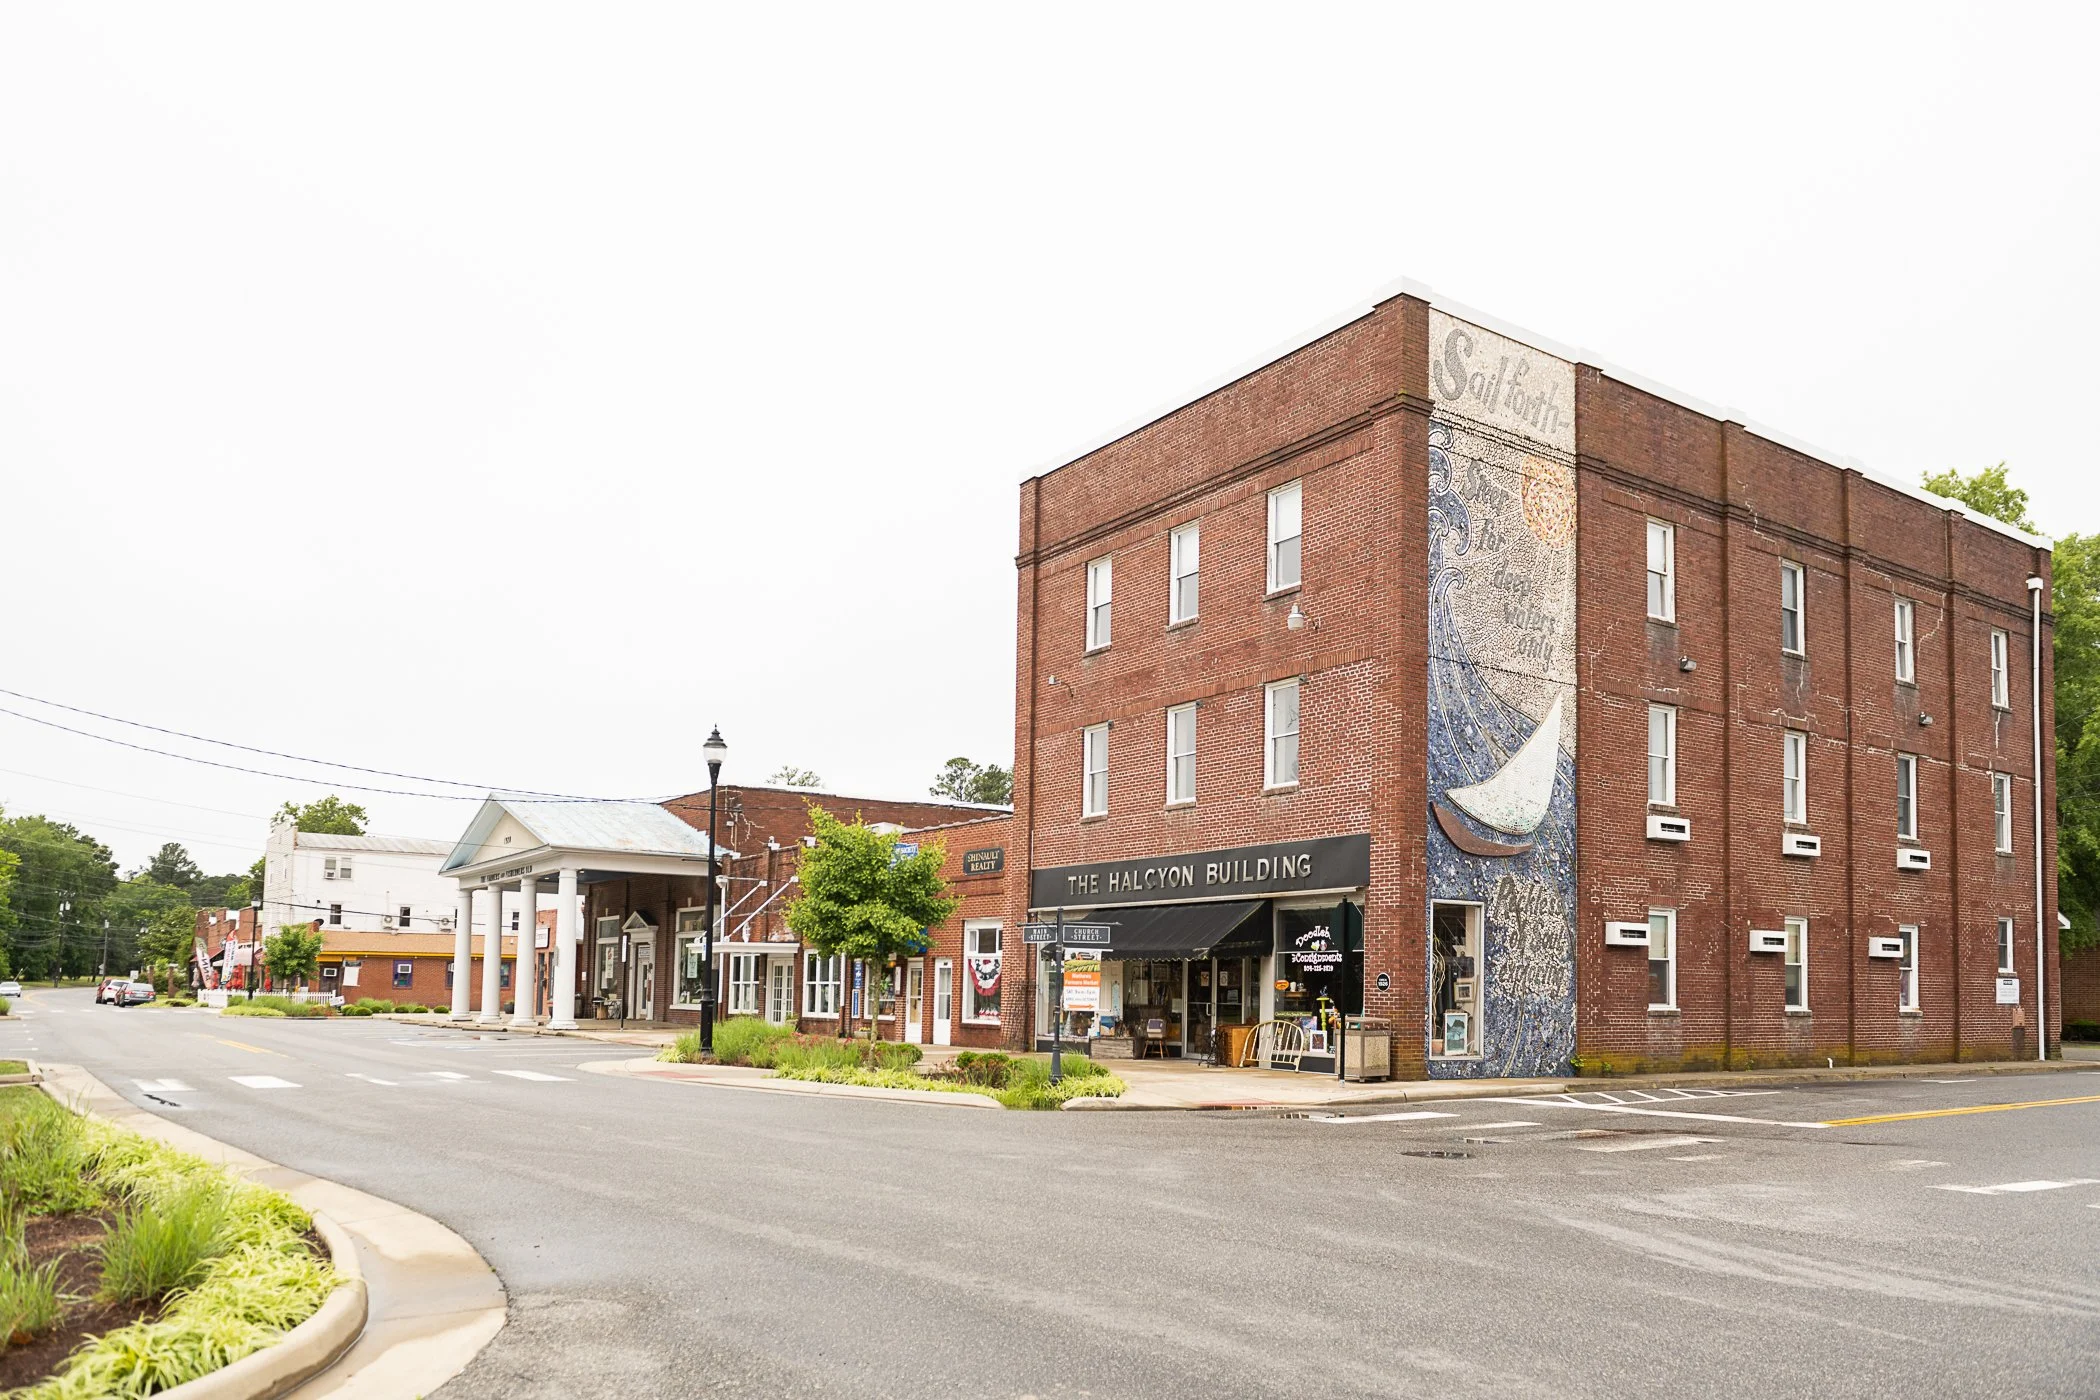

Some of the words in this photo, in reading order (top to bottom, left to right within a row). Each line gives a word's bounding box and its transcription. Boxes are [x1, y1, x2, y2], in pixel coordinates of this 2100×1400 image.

[1433, 328, 1509, 414] Sail
[1464, 460, 1509, 516] Steer
[1478, 518, 1507, 551] for
[1494, 559, 1531, 606] deep
[1518, 634, 1554, 673] only
[970, 860, 996, 871] REALTY
[1067, 874, 1099, 896] THE
[1109, 864, 1195, 893] HALCYON
[1206, 853, 1312, 886] BUILDING
